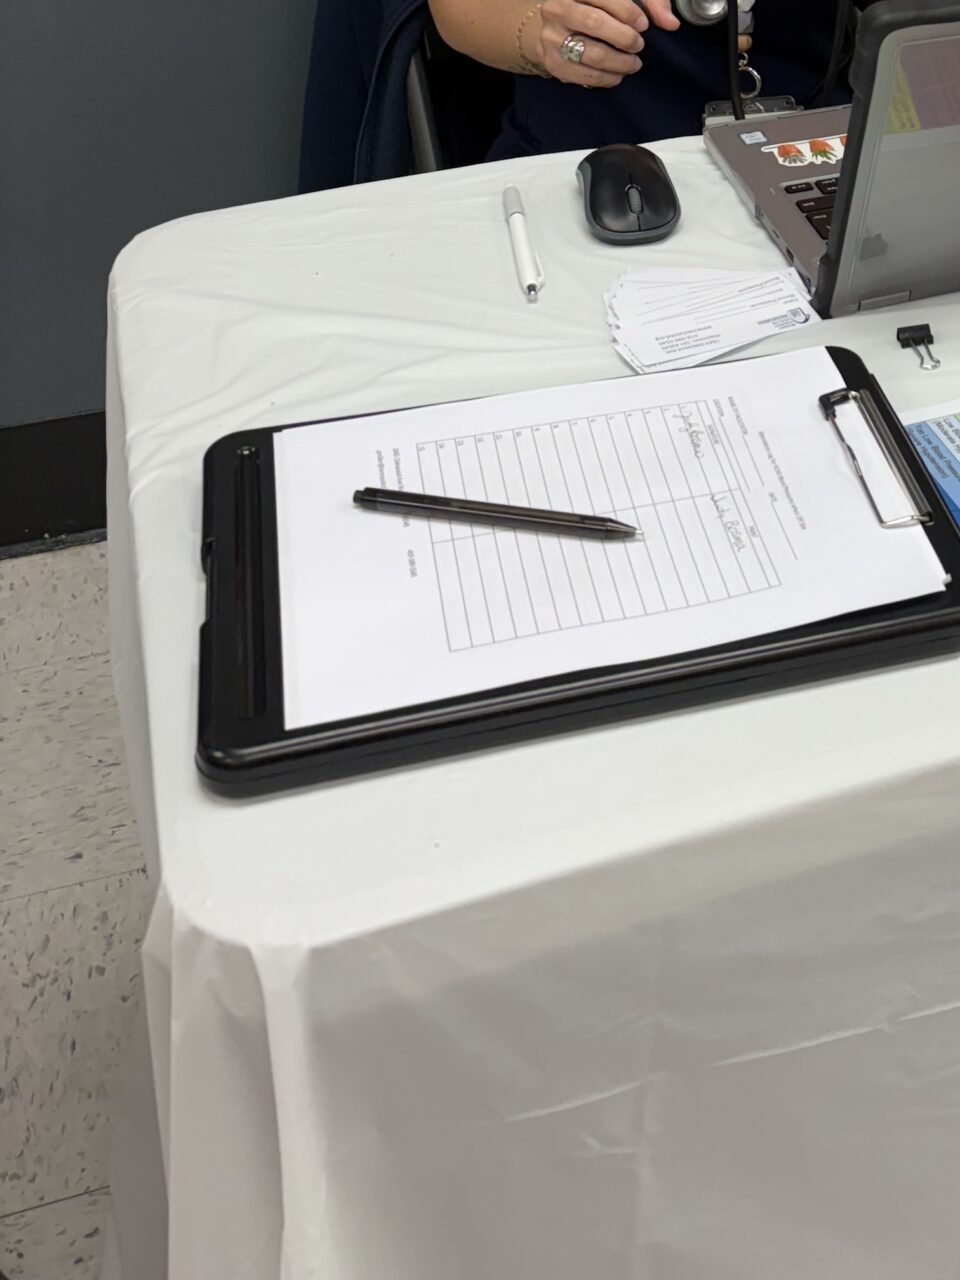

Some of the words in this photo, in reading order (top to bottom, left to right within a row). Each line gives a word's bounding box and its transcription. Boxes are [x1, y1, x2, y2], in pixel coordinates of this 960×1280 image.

[932, 420, 957, 445] (Moderate
[942, 418, 955, 428] Low
[914, 424, 926, 434] Too
[921, 434, 934, 445] Low
[930, 444, 947, 460] Blood
